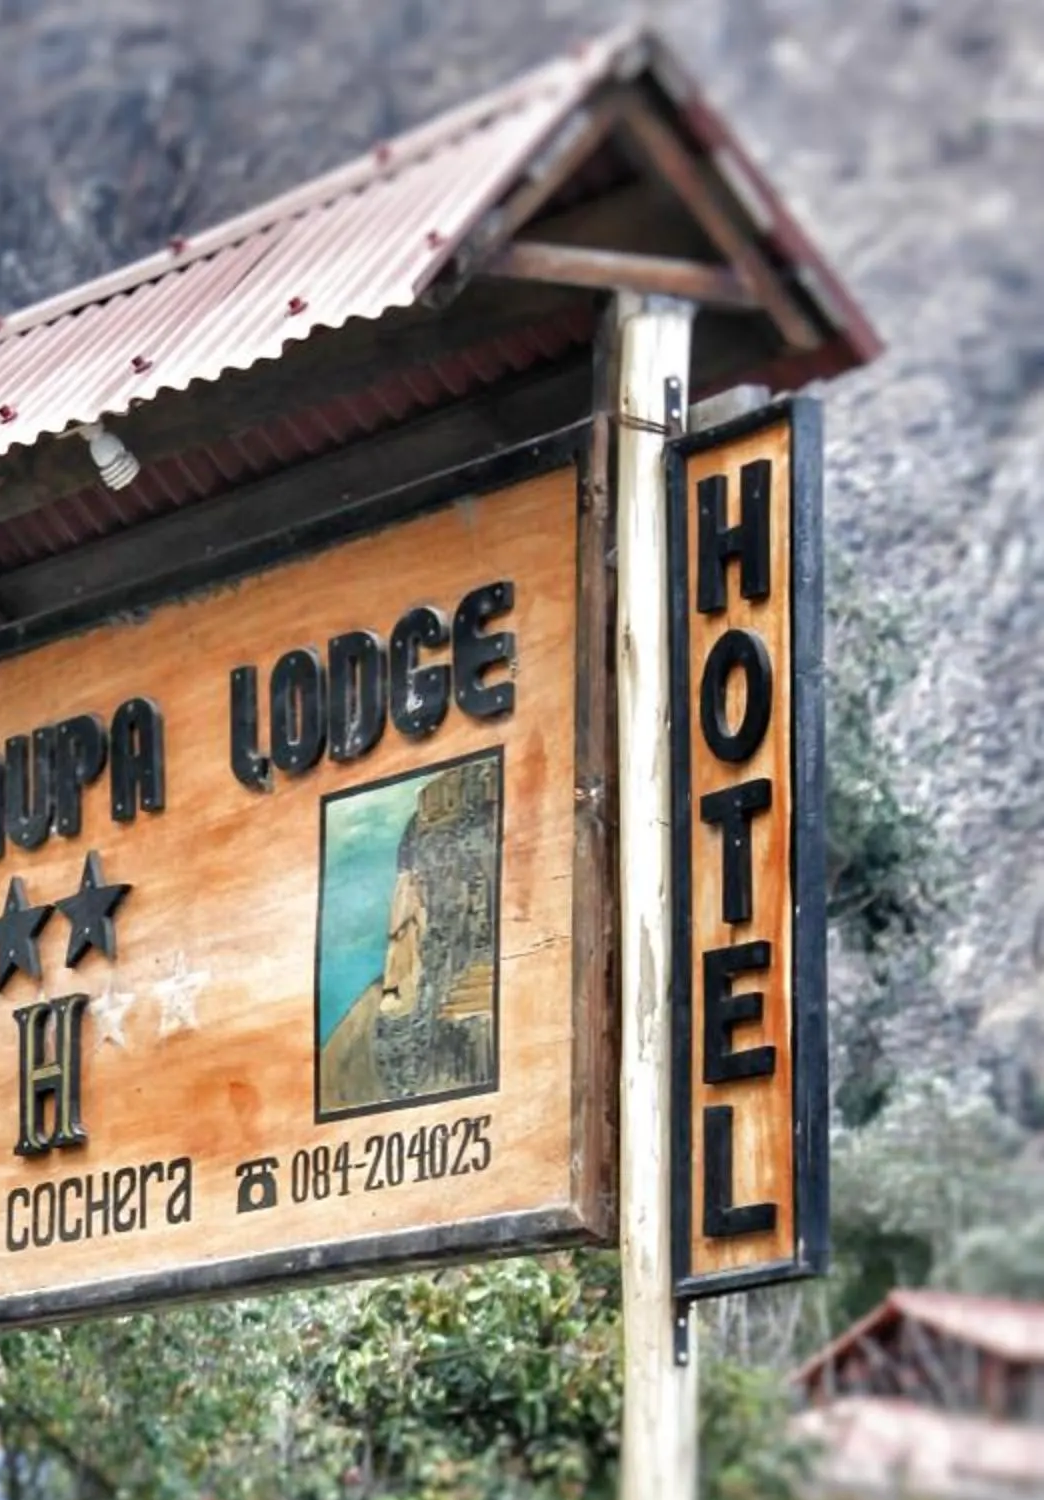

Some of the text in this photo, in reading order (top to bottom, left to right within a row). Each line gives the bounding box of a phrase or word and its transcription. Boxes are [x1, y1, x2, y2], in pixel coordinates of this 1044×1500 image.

[229, 580, 517, 792] LODGE
[696, 458, 775, 1238] HOTEL
[13, 992, 91, 1156] H
[291, 1114, 492, 1203] 084-204025
